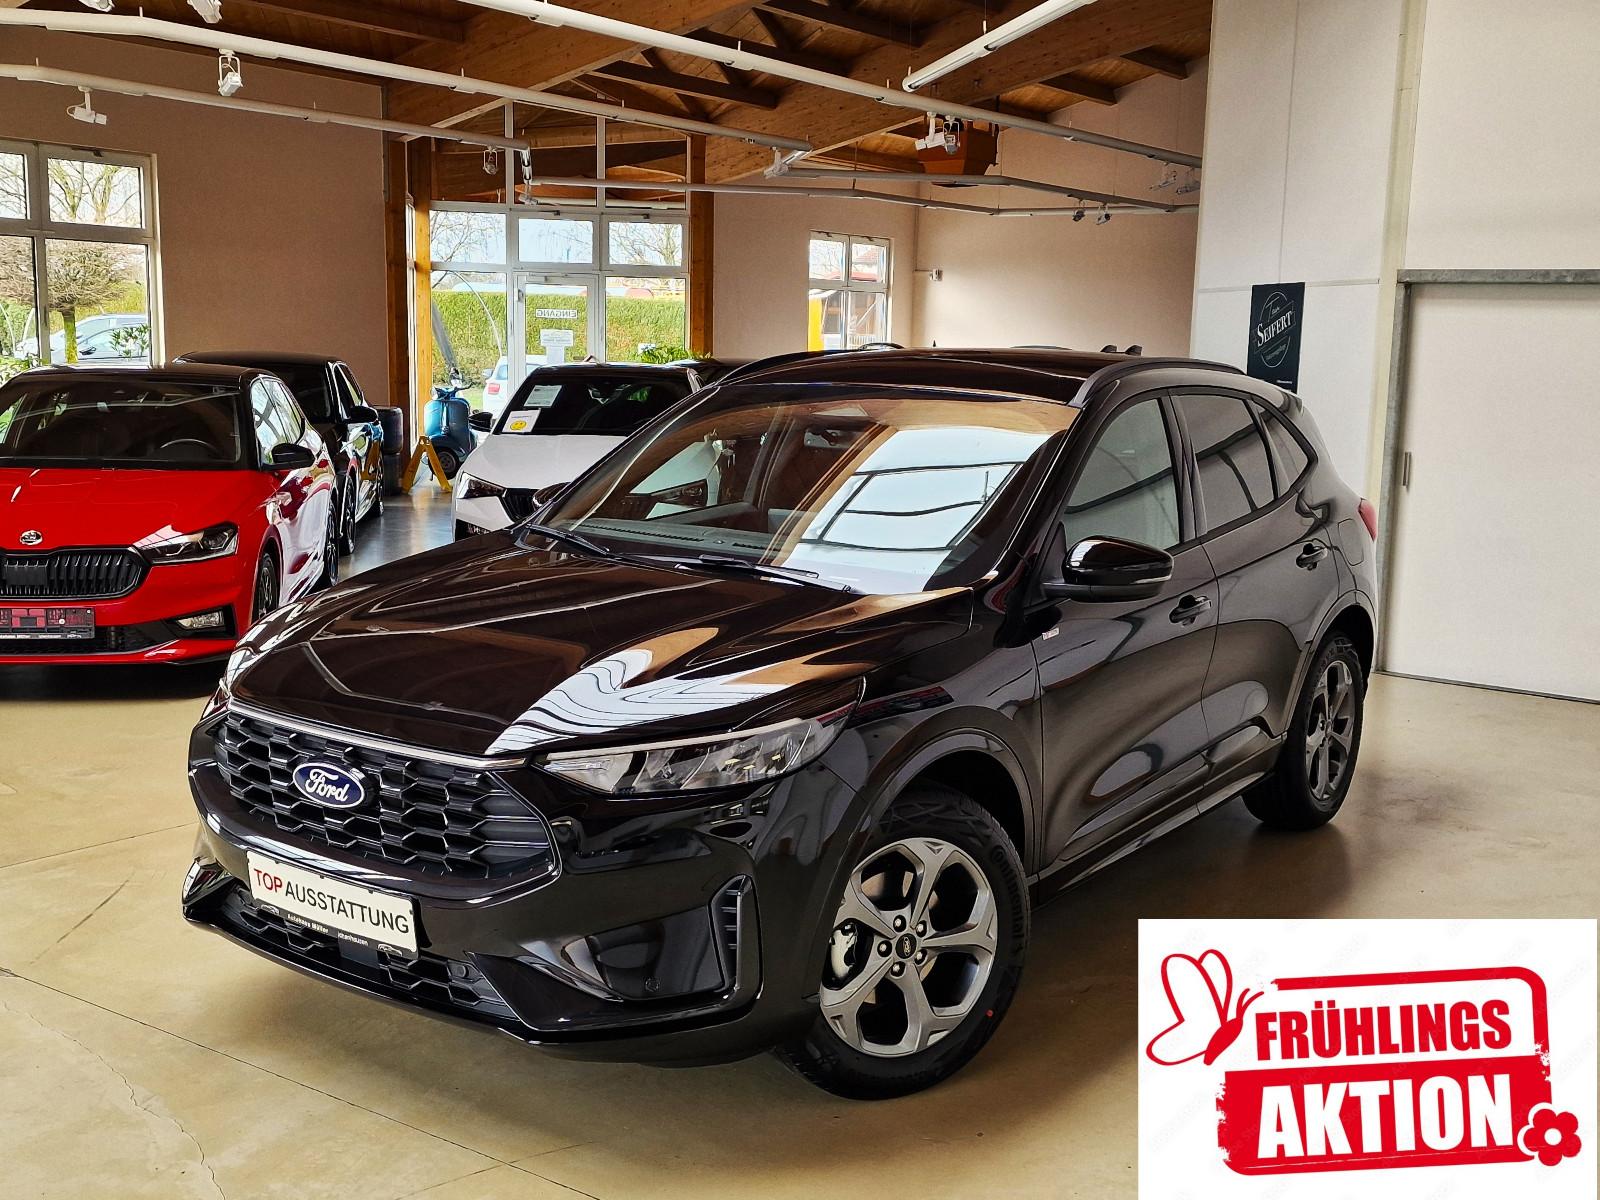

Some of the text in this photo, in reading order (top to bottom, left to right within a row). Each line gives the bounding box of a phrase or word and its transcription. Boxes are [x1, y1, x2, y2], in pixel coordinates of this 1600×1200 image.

[1257, 310, 1293, 347] SEIFERT
[305, 768, 350, 802] Ford
[253, 868, 410, 934] TOP AUSSTATTUNG
